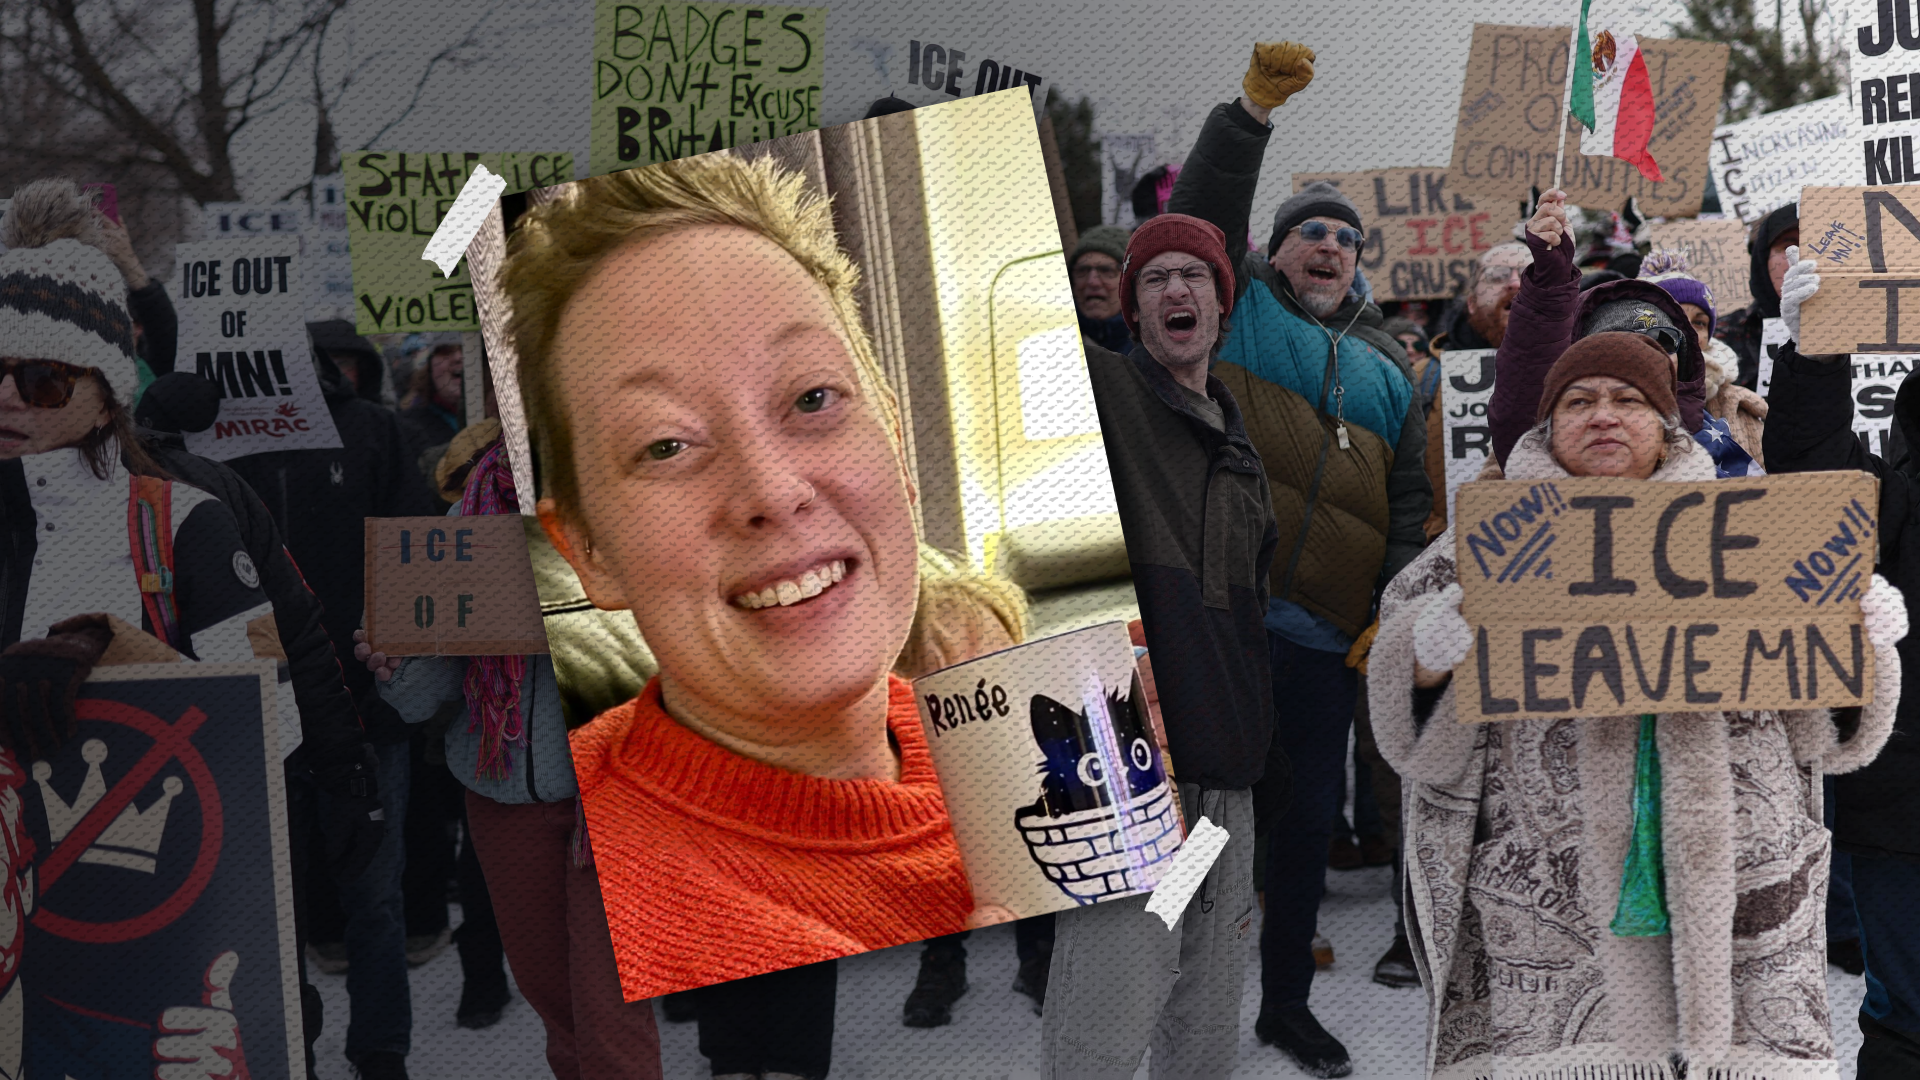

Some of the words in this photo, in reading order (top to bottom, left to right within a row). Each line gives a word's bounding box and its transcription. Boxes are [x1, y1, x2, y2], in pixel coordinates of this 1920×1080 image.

[613, 5, 812, 73] BADGES
[908, 39, 966, 97] ICE
[220, 214, 299, 232] ICE
[1406, 212, 1491, 255] ICE
[1807, 220, 1846, 255] LEAVE
[183, 260, 222, 299] ICE
[232, 256, 291, 297] OUT
[221, 311, 247, 338] OF
[196, 350, 294, 399] MN!
[214, 418, 310, 440] MIRAC
[401, 528, 473, 564] ICE
[1567, 488, 1769, 600] ICE
[1476, 624, 1724, 715] LEAVE
[1740, 624, 1865, 702] MN
[924, 677, 1010, 738] Renée
